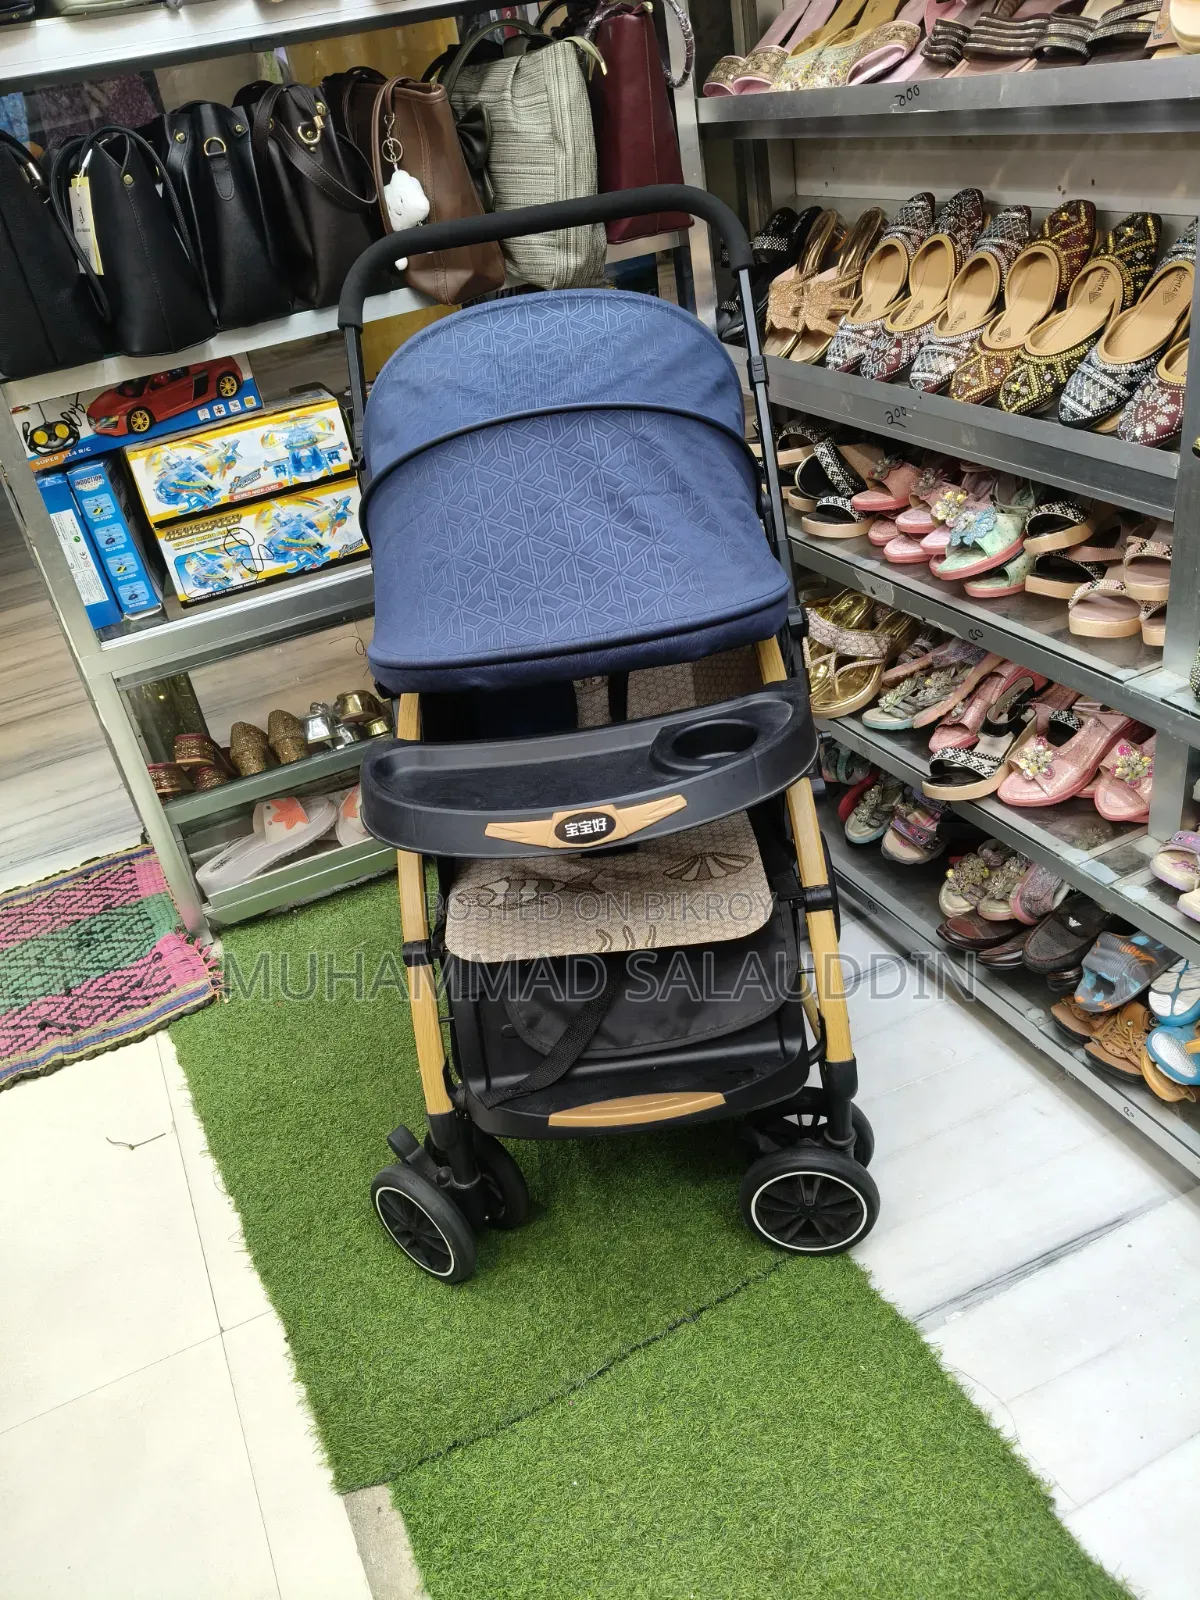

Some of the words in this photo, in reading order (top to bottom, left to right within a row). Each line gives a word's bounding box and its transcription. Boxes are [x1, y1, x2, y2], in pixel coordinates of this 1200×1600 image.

[884, 406, 907, 428] 200
[35, 455, 59, 466] SUPER
[564, 817, 608, 838] 宝宝好
